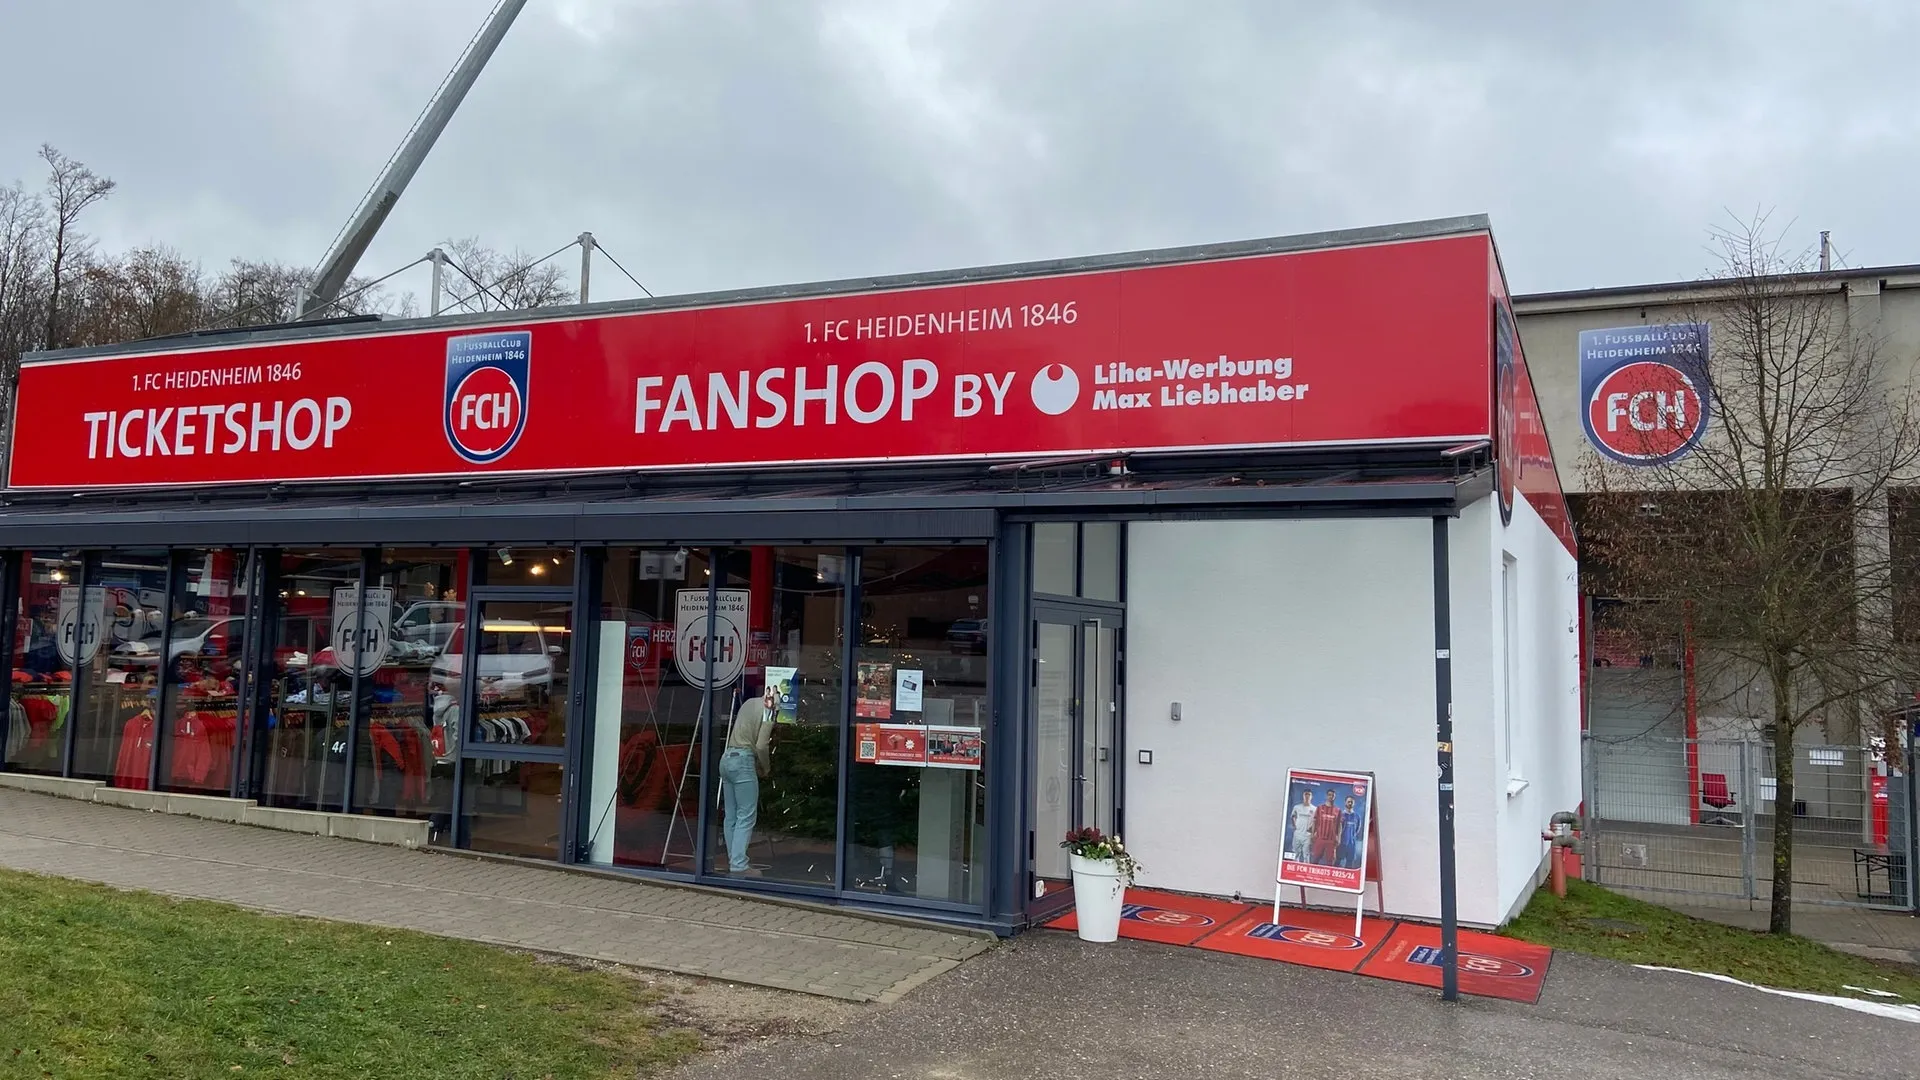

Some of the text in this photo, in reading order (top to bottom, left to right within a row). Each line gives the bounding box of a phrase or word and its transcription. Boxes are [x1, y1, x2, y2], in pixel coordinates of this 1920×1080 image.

[804, 300, 1078, 344] 1. FC HEIDENHEIM 1846
[504, 350, 525, 360] 1846
[1587, 346, 1666, 359] HEIDENHEIM
[1593, 336, 1601, 346] 1.
[132, 362, 302, 391] 1. FC HEIDENHEIM 1846
[1093, 354, 1294, 386] Liha-Werbung
[634, 358, 1017, 434] FANSHOP BY
[1092, 379, 1310, 411] Max Liebhaber
[460, 392, 511, 430] FCH
[1607, 390, 1685, 432] FCH
[83, 396, 353, 459] TICKETSHOP
[342, 628, 379, 653] FCH
[688, 635, 734, 663] FCH
[1287, 864, 1296, 872] DIE
[1309, 867, 1330, 876] TRIKOTS
